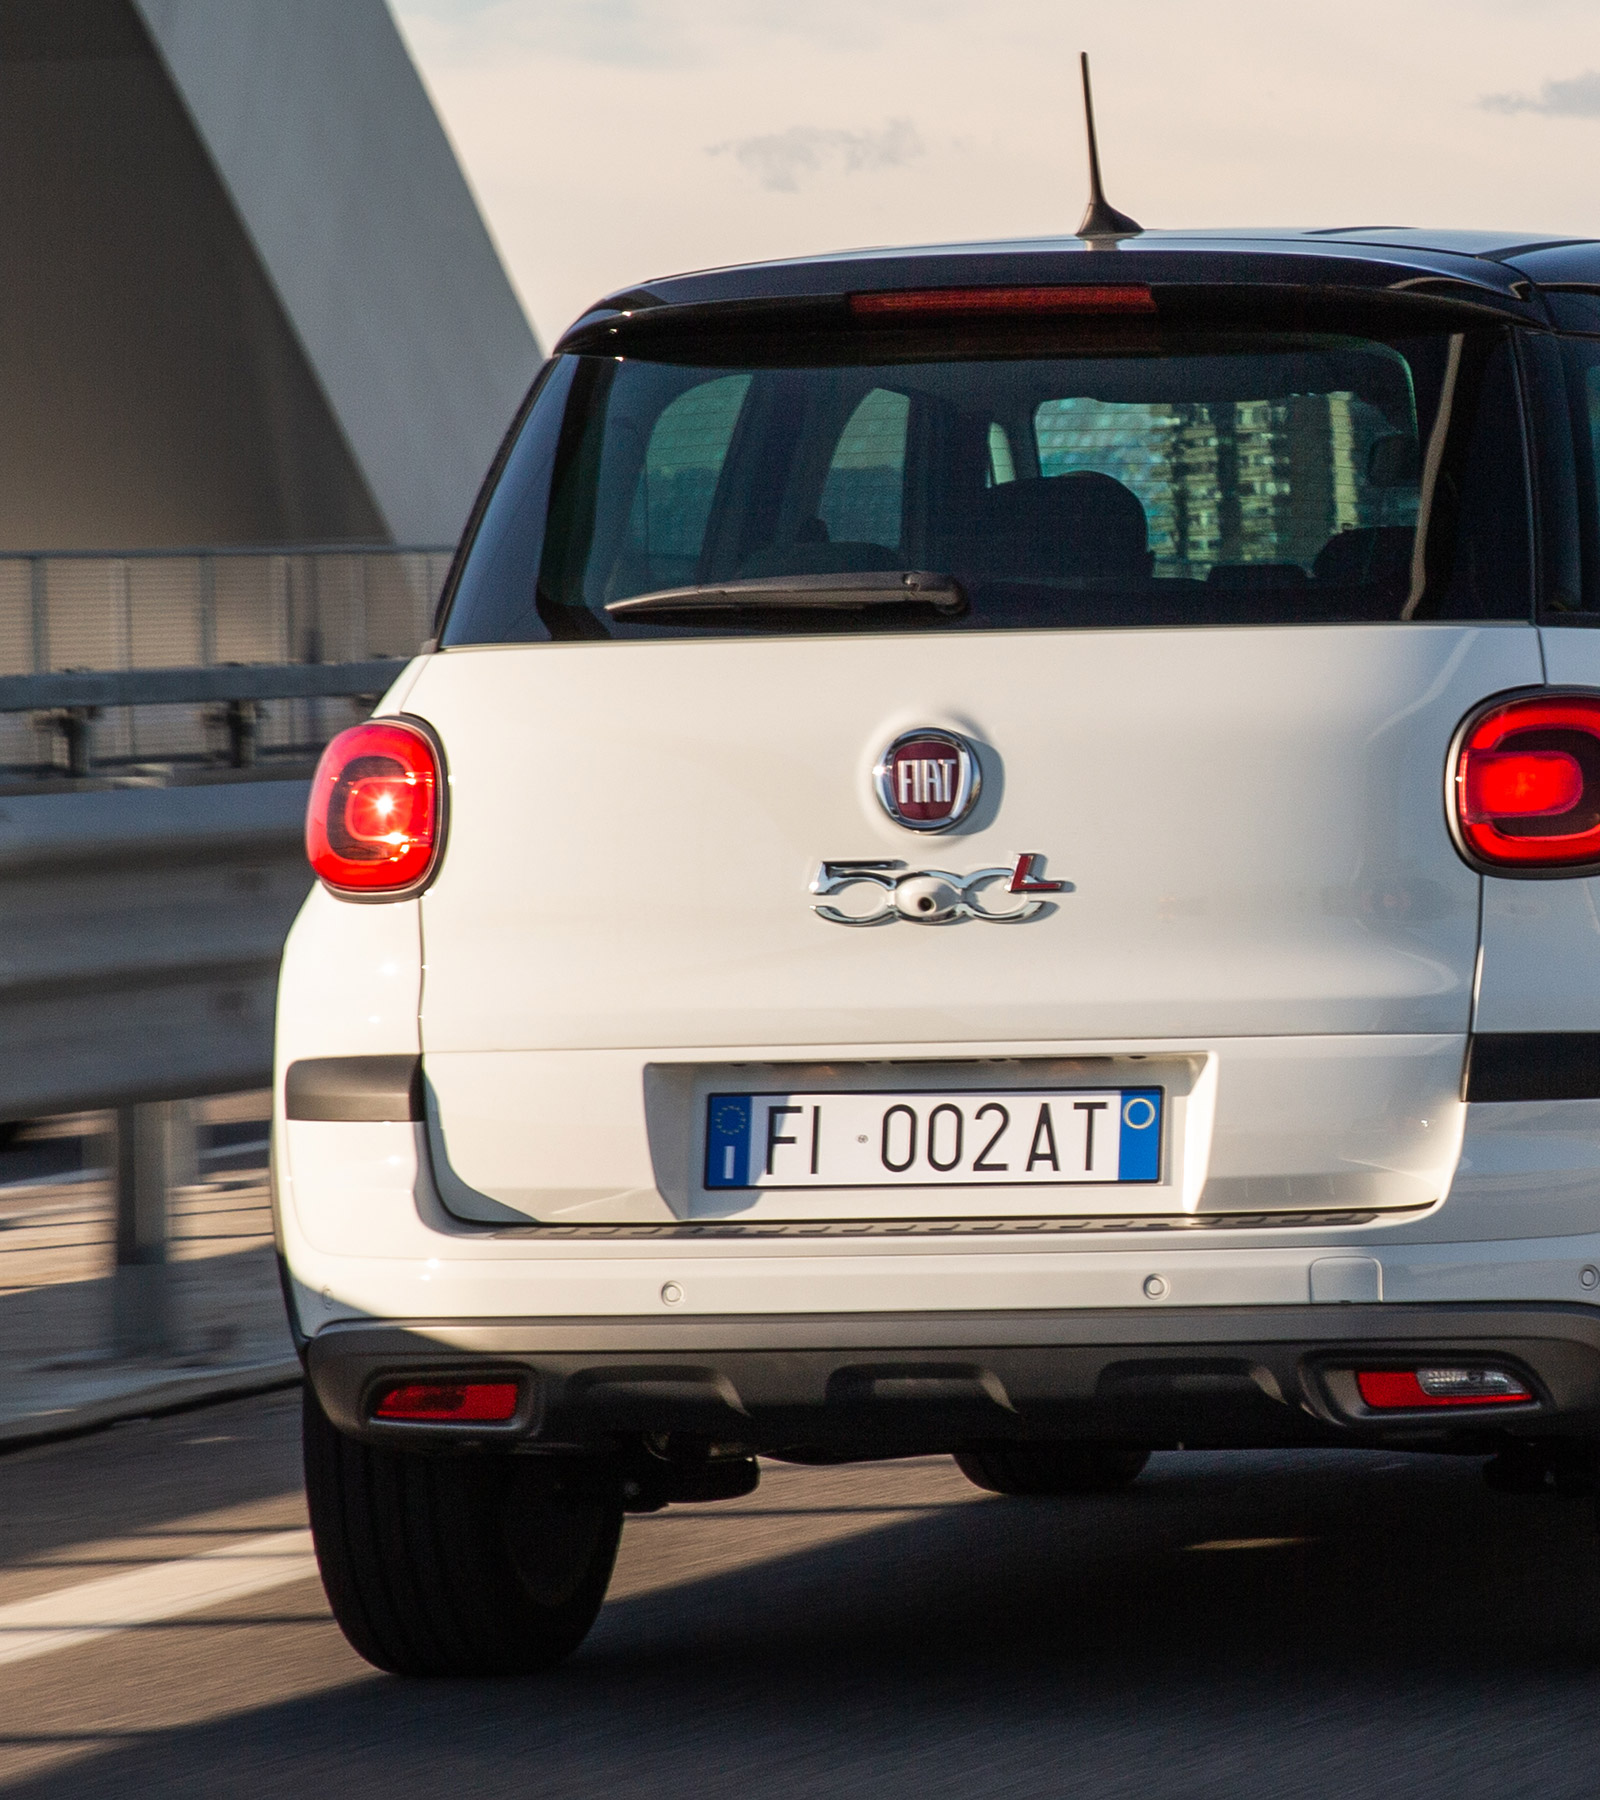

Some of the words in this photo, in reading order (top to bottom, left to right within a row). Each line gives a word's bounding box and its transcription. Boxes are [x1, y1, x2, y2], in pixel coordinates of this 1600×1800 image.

[897, 758, 957, 804] FIAT
[766, 1105, 821, 1175] FI
[881, 1101, 1109, 1173] 002AT
